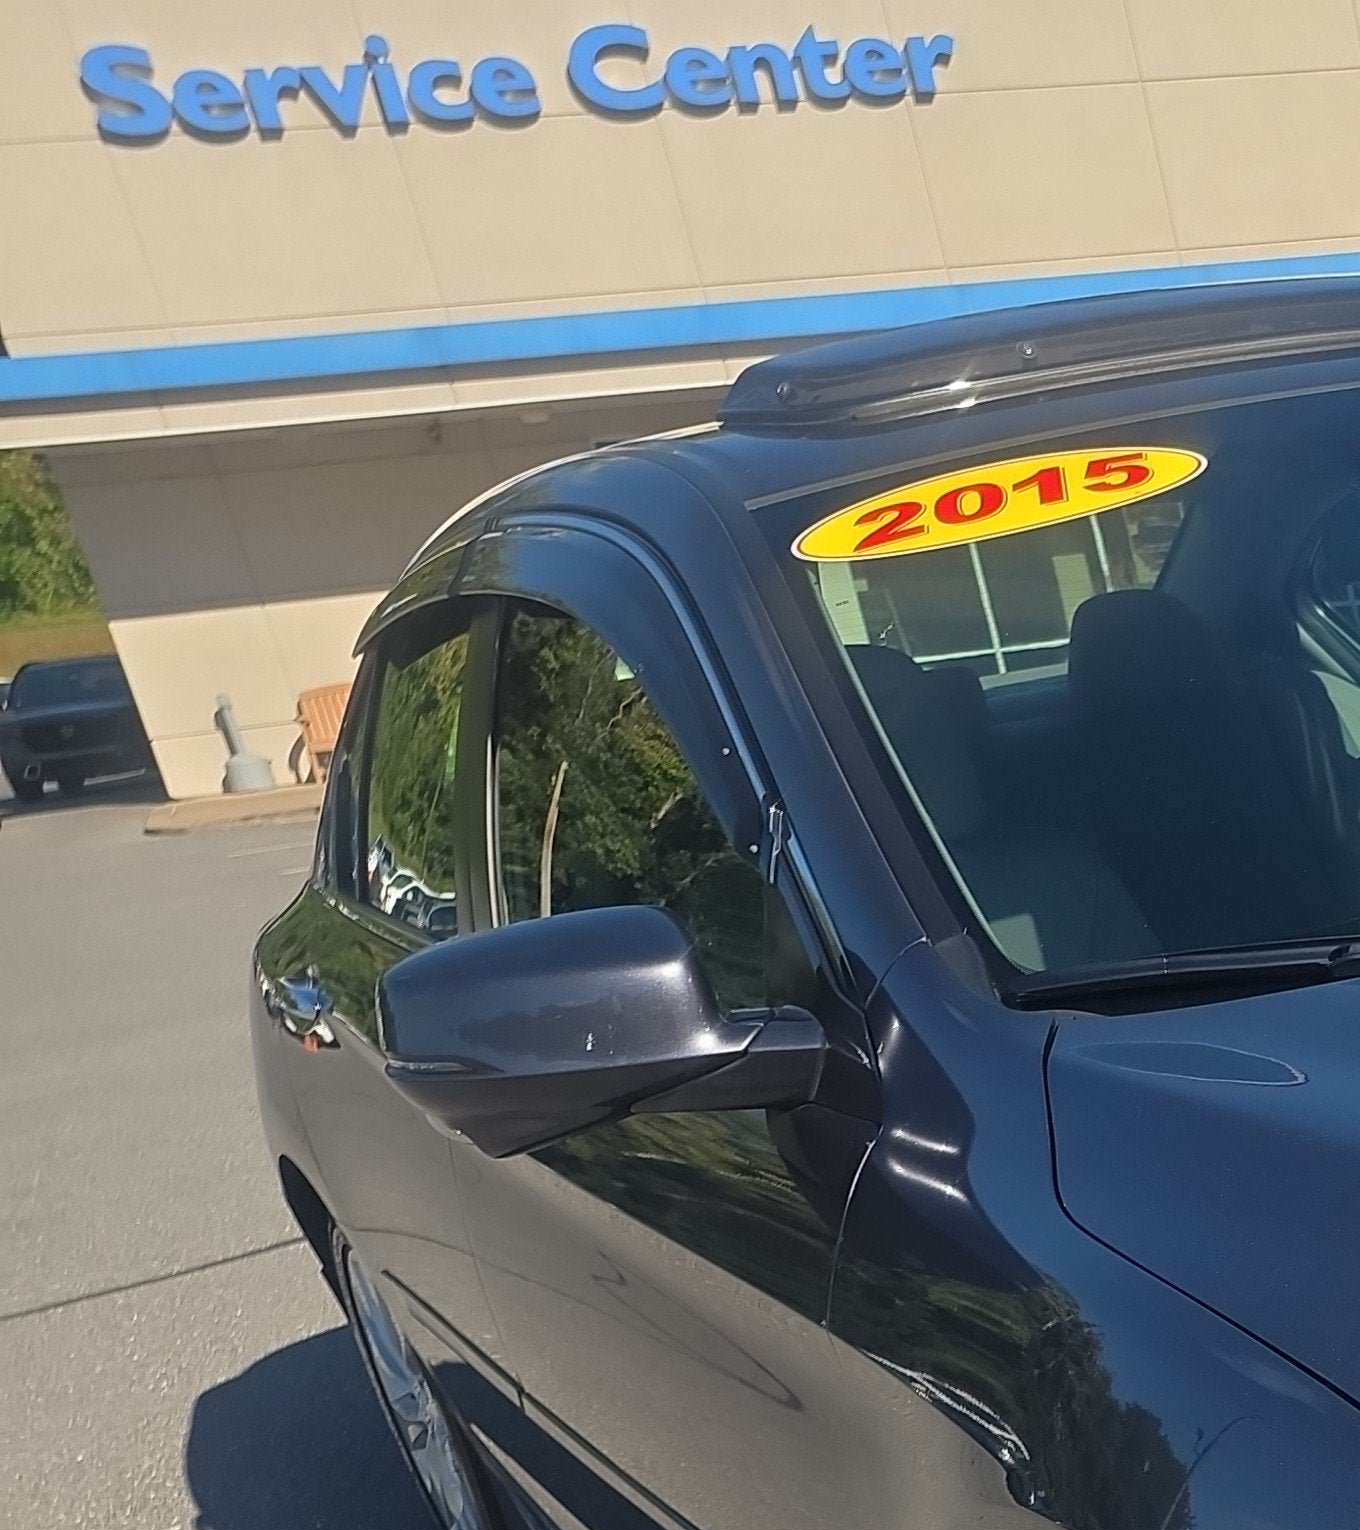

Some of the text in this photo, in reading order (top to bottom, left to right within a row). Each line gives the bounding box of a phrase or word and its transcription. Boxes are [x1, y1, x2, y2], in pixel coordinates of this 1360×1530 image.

[78, 22, 954, 147] Service Center
[852, 452, 1155, 554] 2015
